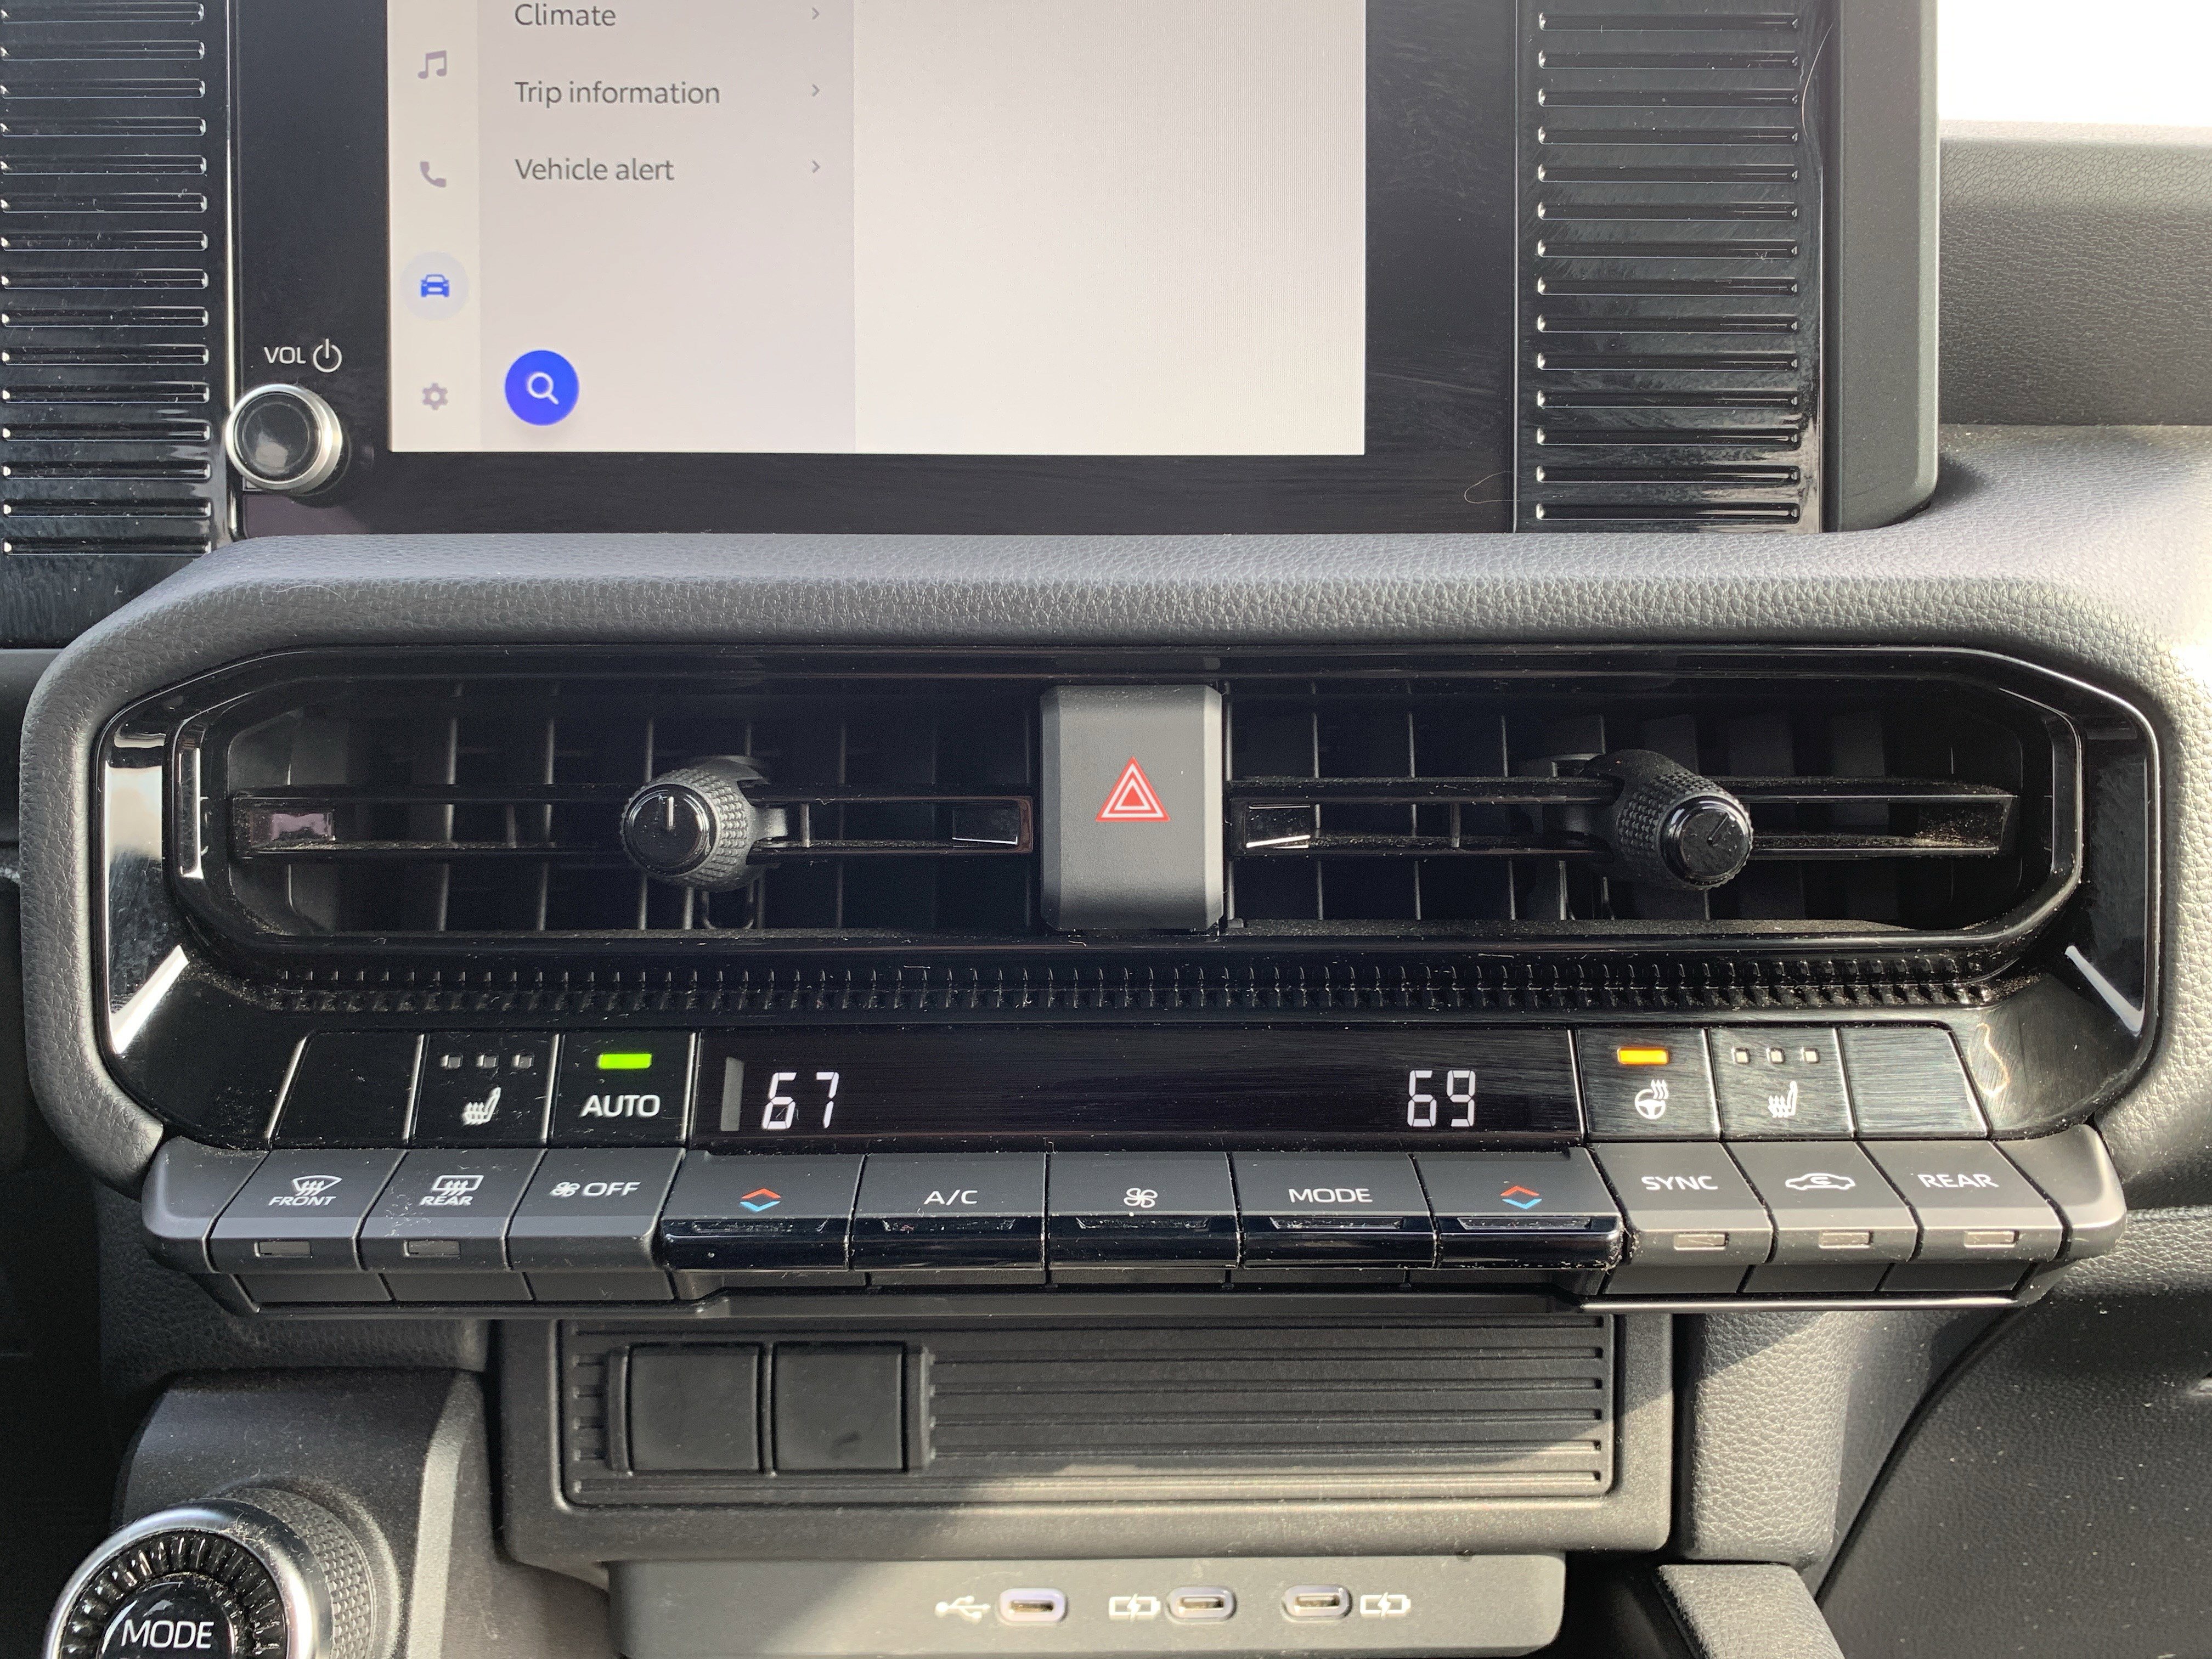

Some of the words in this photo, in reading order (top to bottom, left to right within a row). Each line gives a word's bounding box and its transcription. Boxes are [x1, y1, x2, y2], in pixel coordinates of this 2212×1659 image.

[515, 3, 616, 26] Climate
[515, 81, 562, 109] Trip
[569, 81, 720, 104] information
[515, 157, 608, 180] Vehicle
[616, 157, 675, 180] alert
[263, 346, 306, 364] VOL
[580, 1094, 661, 1117] AUTO
[761, 1071, 839, 1130] 67
[1407, 1070, 1476, 1127] 69
[582, 1182, 641, 1197] OFF
[1641, 1176, 1718, 1190] SYNC
[1917, 1173, 2000, 1188] REAR
[268, 1196, 337, 1206] FRONT
[420, 1196, 473, 1206] REAR
[923, 1189, 978, 1205] A/C
[1288, 1188, 1373, 1203] MODE
[121, 1619, 215, 1649] MODE
